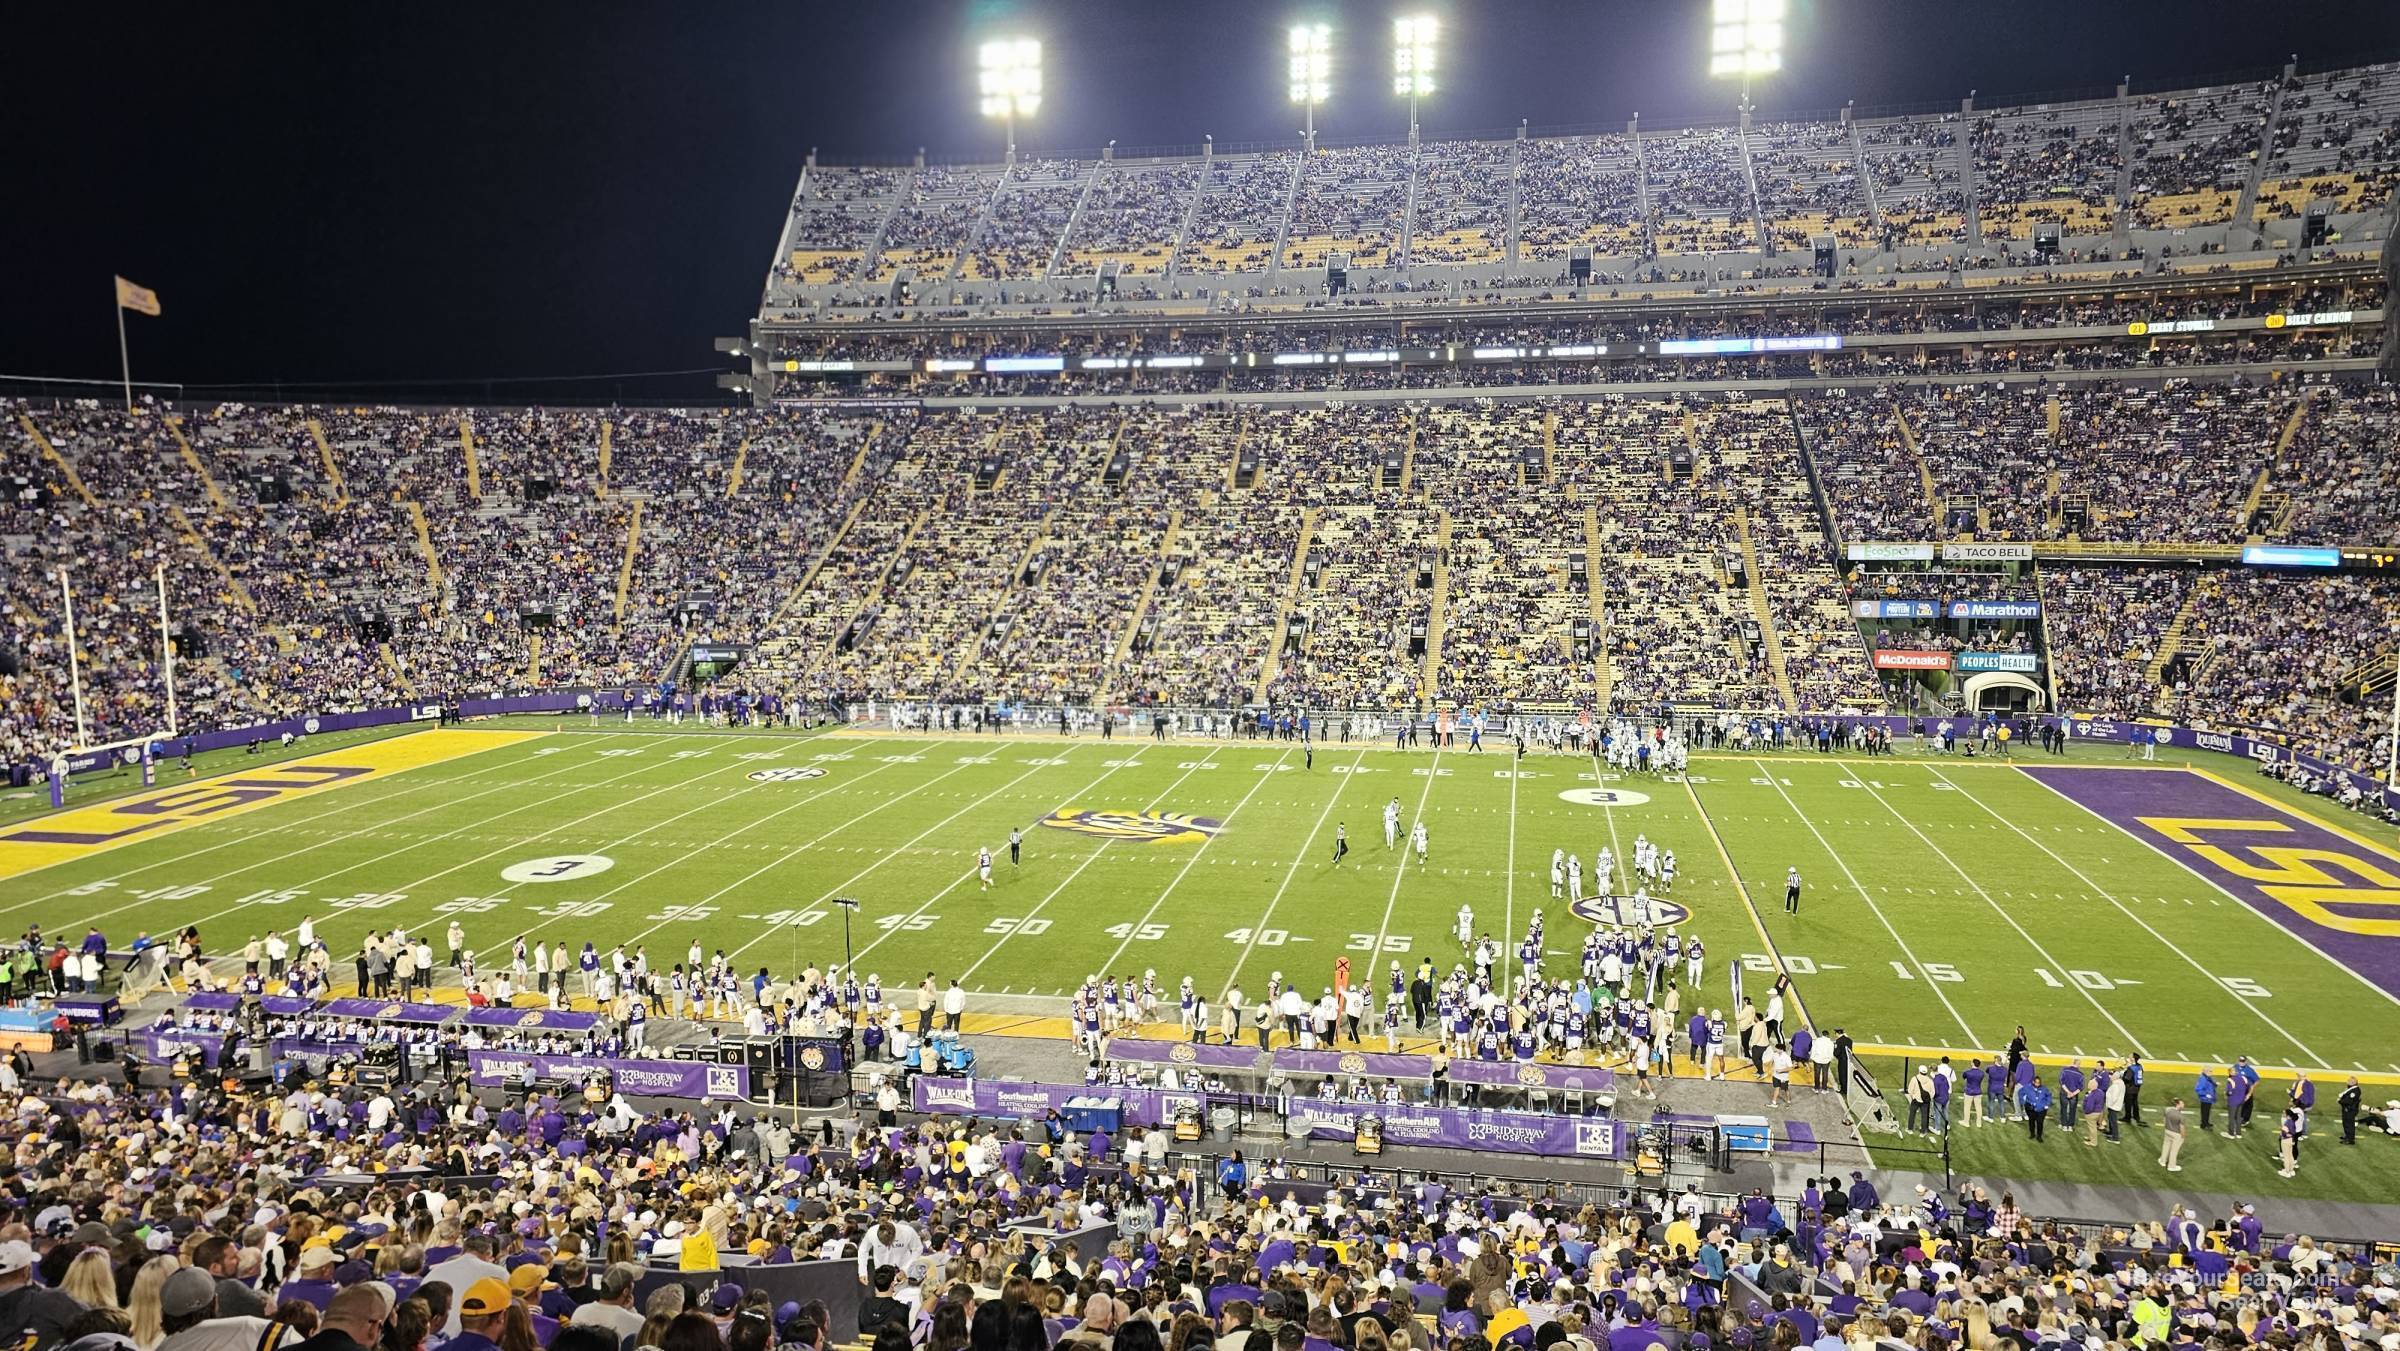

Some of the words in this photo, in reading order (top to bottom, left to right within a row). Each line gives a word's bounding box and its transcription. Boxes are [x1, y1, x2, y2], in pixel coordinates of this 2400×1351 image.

[2314, 311, 2352, 324] CANNON
[1605, 394, 1624, 402] 305
[1826, 389, 1846, 398] 410
[960, 406, 977, 415] 300
[1864, 545, 1916, 557] EcoSport
[1965, 548, 1996, 557] TACO
[1999, 548, 2028, 557] BELL
[1971, 604, 2036, 616] Marathon
[1878, 654, 1948, 666] McDonald's
[1962, 656, 1999, 668] PEOPLES
[2002, 658, 2034, 668] HEALTH
[2196, 732, 2232, 750] LOUISIANA
[748, 767, 828, 781] SEC
[1412, 768, 1454, 776] 35
[1493, 770, 1536, 778] 30
[1750, 778, 1794, 786] 15
[1838, 780, 1884, 788] 10
[1589, 792, 1618, 802] 3
[0, 766, 375, 845] LSU
[530, 861, 586, 876] 3
[2133, 816, 2400, 938] LSU
[68, 881, 120, 896] 5
[137, 886, 214, 900] 10
[235, 889, 312, 904] 15
[329, 892, 409, 908] 20
[432, 897, 512, 913] 25
[538, 901, 615, 917] 30
[646, 906, 721, 921] 35
[762, 910, 829, 927] 40
[874, 914, 942, 930] 45
[983, 918, 1054, 936] 50
[1104, 922, 1170, 940] 45
[1223, 928, 1290, 946] 40
[1345, 933, 1414, 952] 35
[1740, 953, 1818, 974] 20
[1889, 961, 1966, 982] 15
[2033, 968, 2116, 990] 10
[2218, 976, 2274, 998] 5
[1569, 1021, 1582, 1031] 95
[633, 1070, 684, 1082] BRIDGEWAY
[998, 1091, 1048, 1102] SouthernAIR
[1385, 1115, 1440, 1127] SouthernAIR
[1485, 1124, 1547, 1139] BRIDGEWAY
[1496, 1134, 1535, 1144] HOSPICE
[1580, 1126, 1610, 1144] H&E
